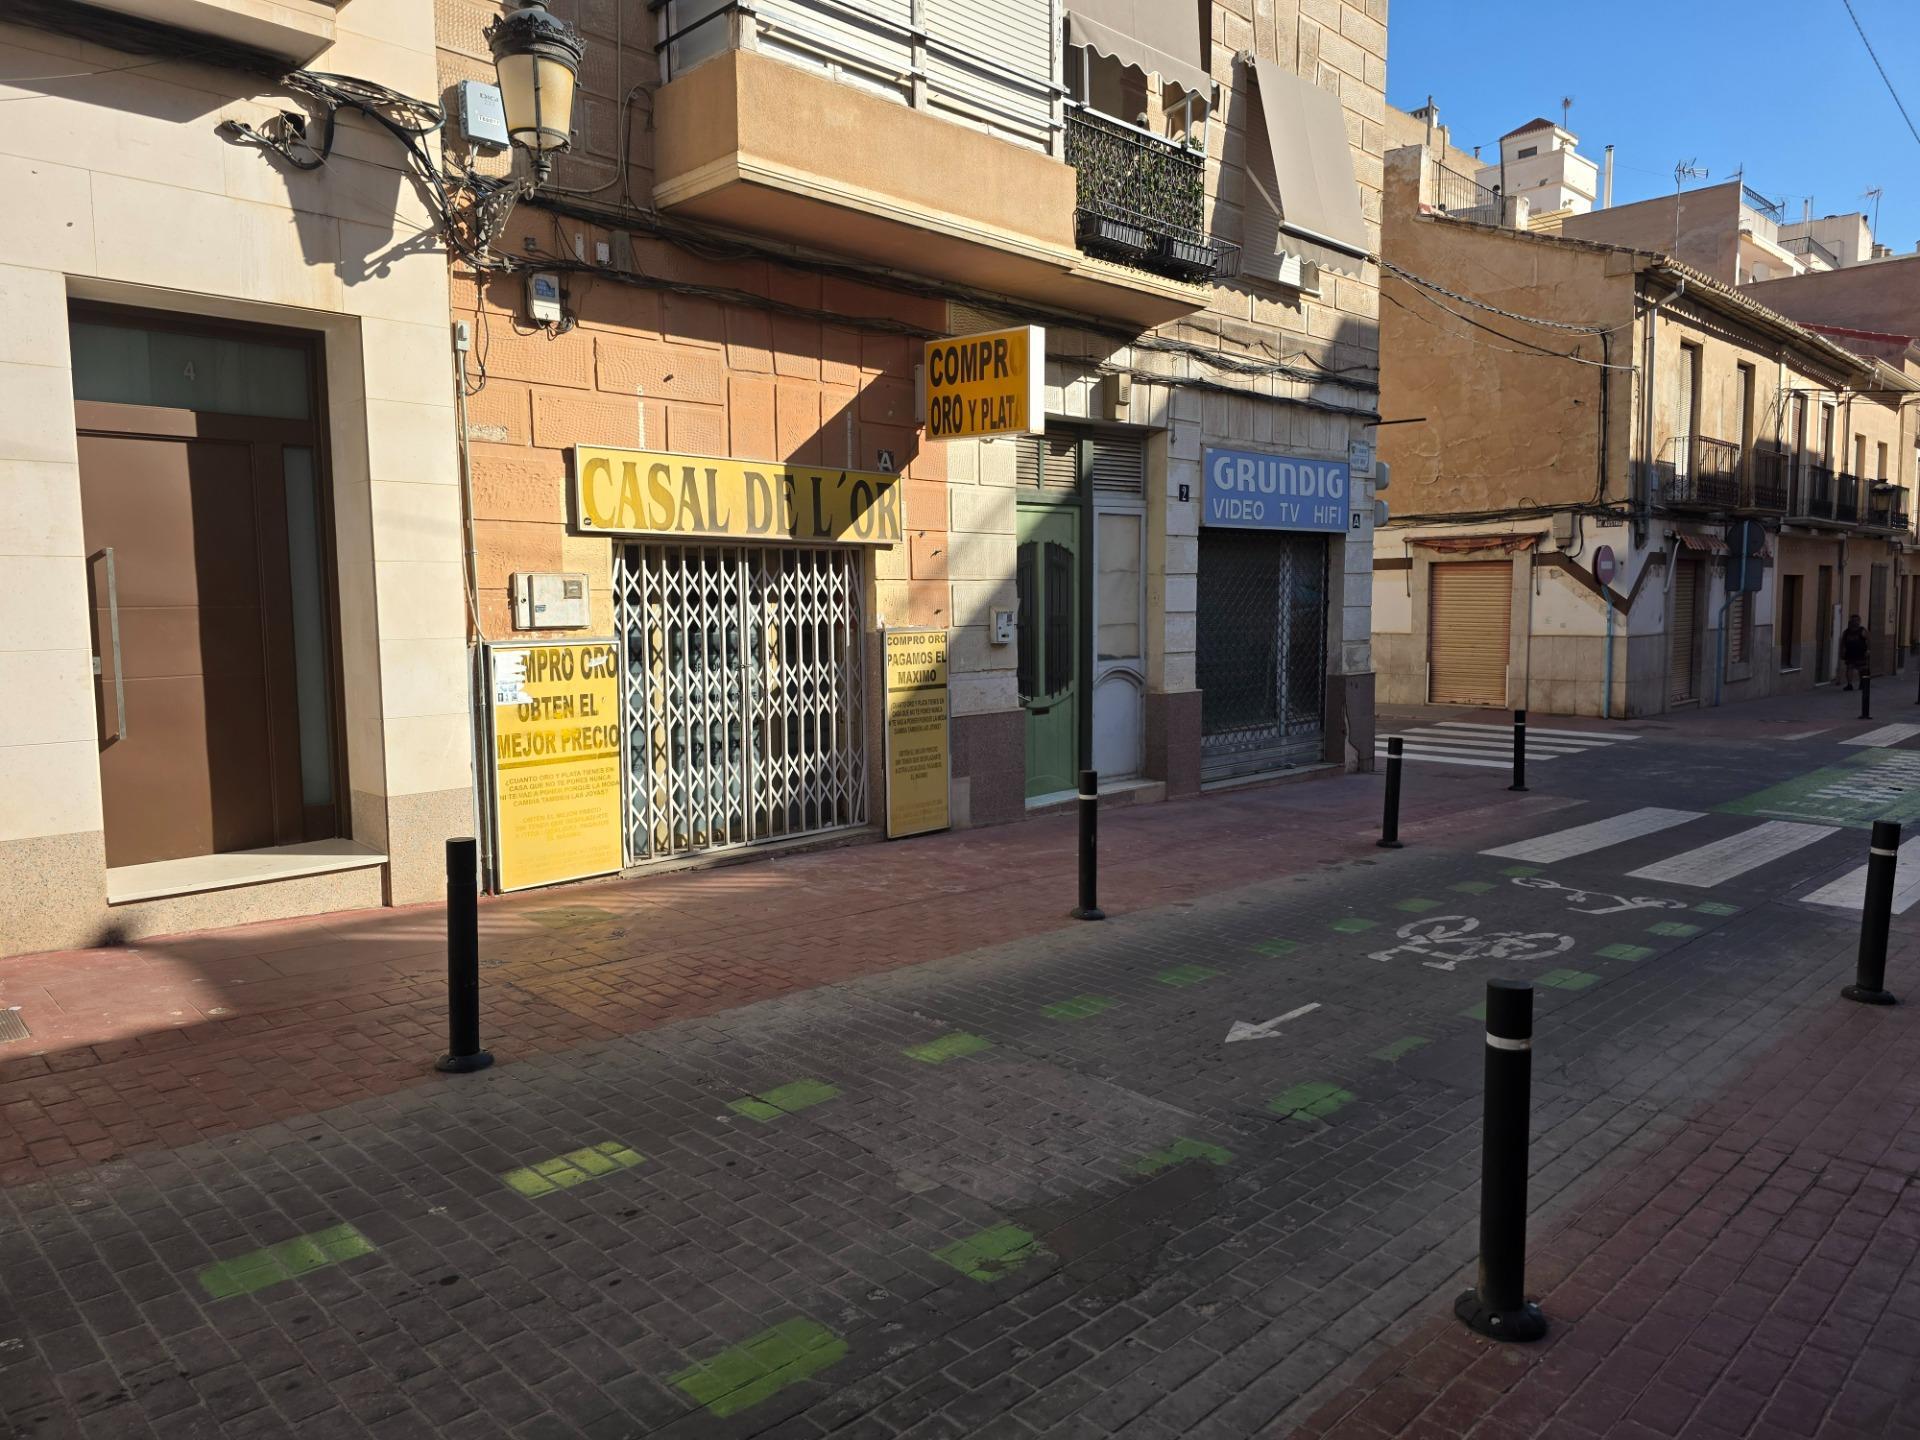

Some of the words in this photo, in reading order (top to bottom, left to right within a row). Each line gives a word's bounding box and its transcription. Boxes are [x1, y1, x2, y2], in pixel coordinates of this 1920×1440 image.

[183, 361, 196, 381] 4
[931, 394, 963, 435] ORO
[967, 399, 977, 431] Y
[880, 453, 893, 471] A
[1213, 456, 1343, 499] GRUNDIG
[582, 457, 730, 533] CASAL
[744, 471, 799, 537] DE
[1180, 486, 1189, 501] 2
[1213, 498, 1264, 520] VIDEO
[1280, 502, 1301, 522] TV
[1314, 505, 1342, 525] HIFI
[888, 635, 925, 645] COMPRO
[888, 652, 933, 667] PAGAMOS
[936, 651, 947, 662] EL
[898, 669, 937, 684] MAXIMO
[518, 695, 574, 722] OBTEN
[580, 693, 599, 717] EL
[498, 729, 557, 759] MEJOR
[562, 724, 619, 753] PRECIO
[561, 770, 581, 778] PLATA
[509, 784, 528, 792] CASA
